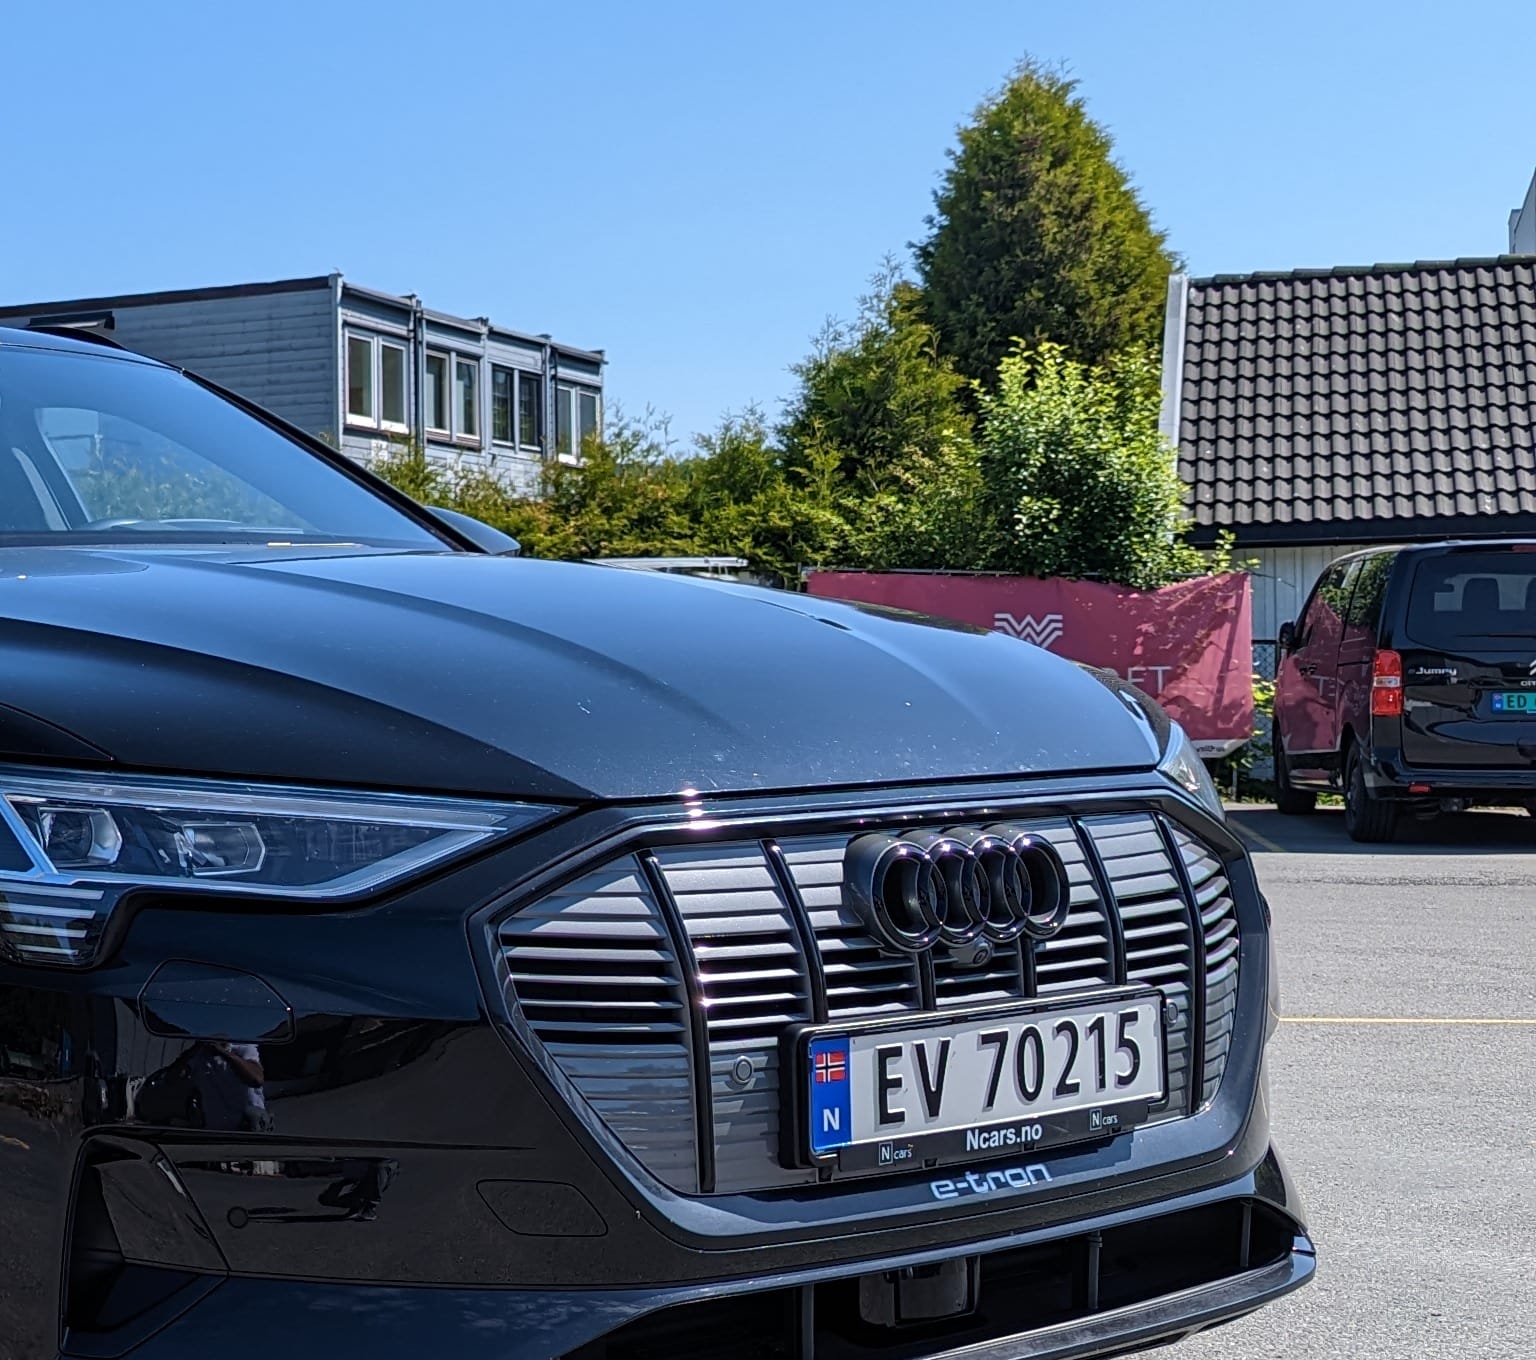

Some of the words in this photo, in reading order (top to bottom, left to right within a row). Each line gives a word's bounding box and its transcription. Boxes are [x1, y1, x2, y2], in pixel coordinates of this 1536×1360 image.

[876, 1037, 951, 1126] EV
[979, 1010, 1141, 1109] 70215
[823, 1108, 839, 1131] N
[966, 1123, 1043, 1152] Ncars.no
[930, 1163, 1054, 1200] e-tron
